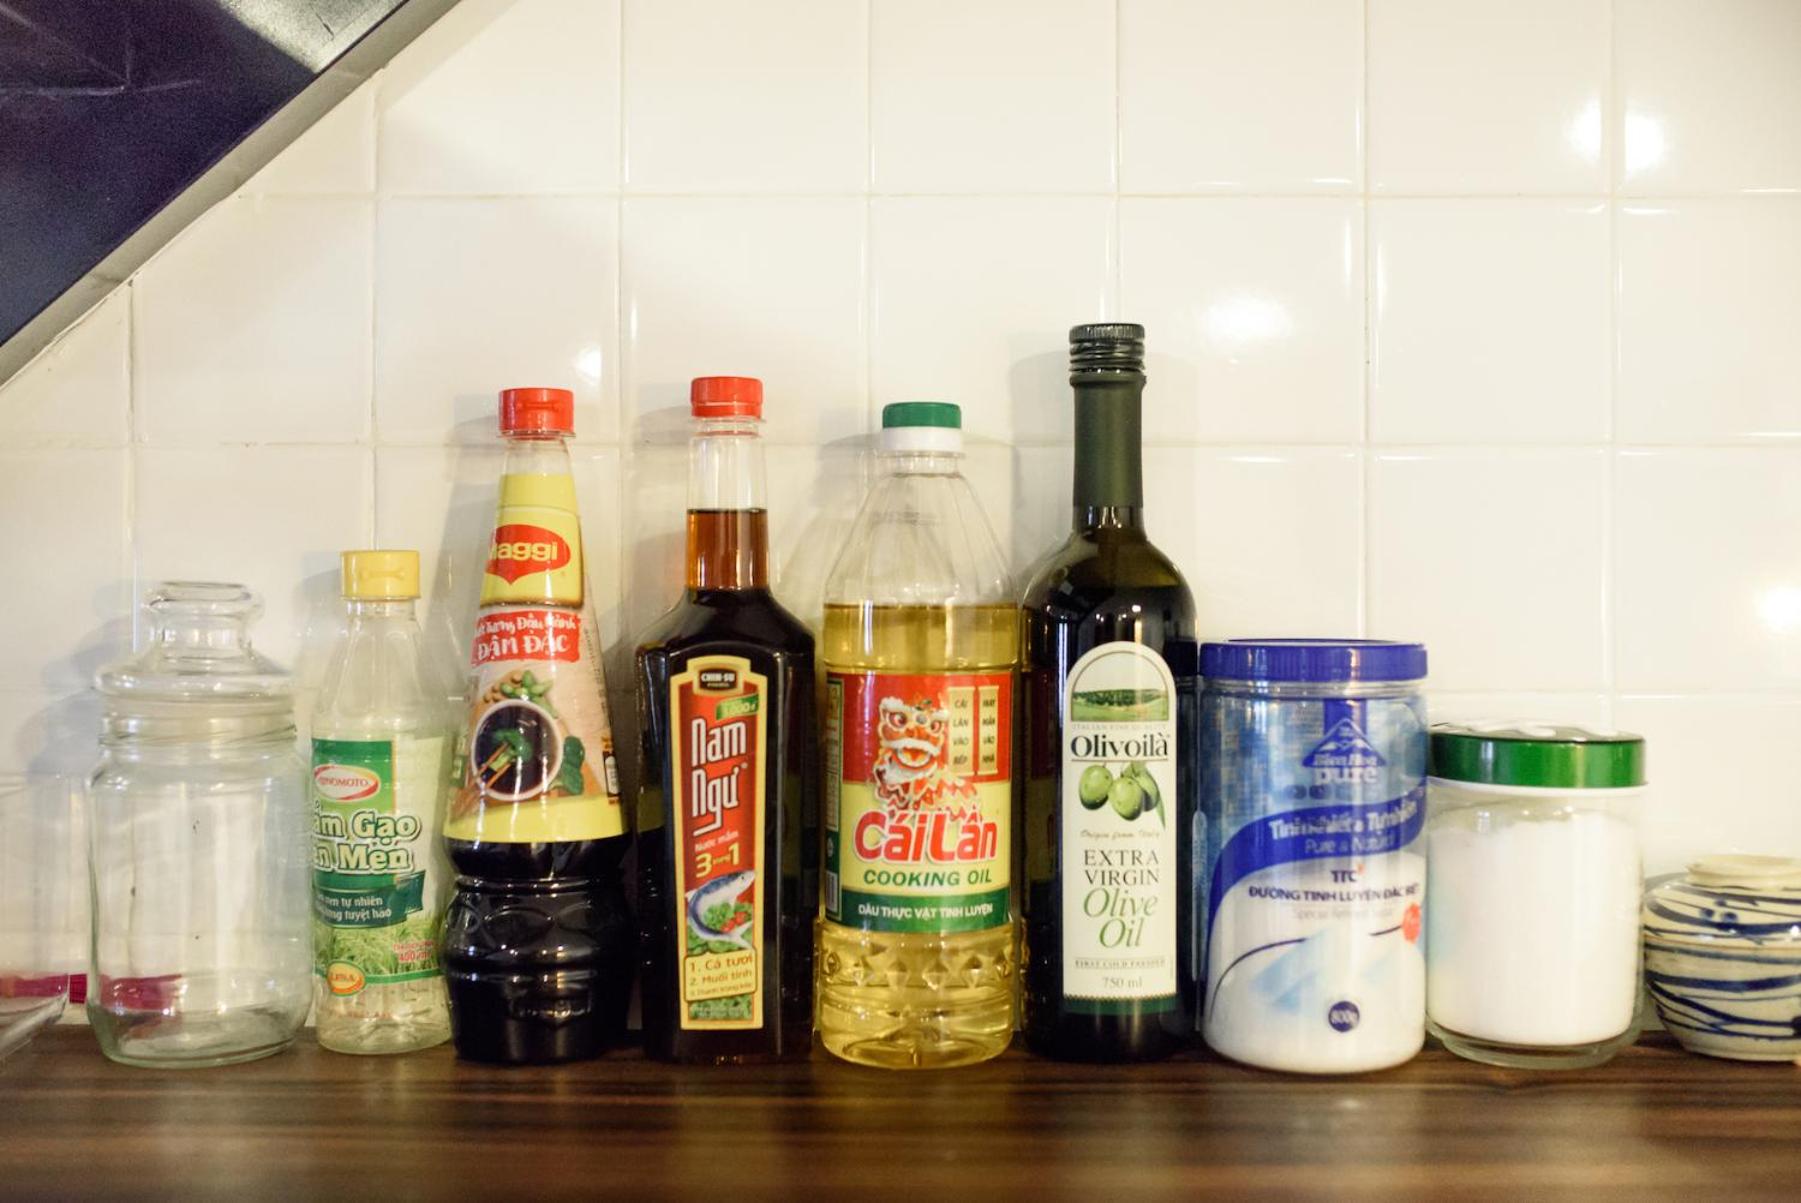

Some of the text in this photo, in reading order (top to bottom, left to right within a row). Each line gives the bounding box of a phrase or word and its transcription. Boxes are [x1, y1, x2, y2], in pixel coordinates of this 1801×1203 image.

[691, 717, 746, 768] Nam
[1070, 731, 1168, 758] Olivoilà
[692, 766, 739, 837] Ngư
[696, 852, 713, 878] 3
[728, 842, 740, 866] 1
[1084, 849, 1159, 866] EXTRA
[863, 869, 993, 887] COOKING OIL
[1085, 868, 1160, 886] VIRGIN
[1083, 887, 1158, 918] Olive
[1099, 917, 1144, 949] Oil
[1103, 976, 1143, 989] 750 ml
